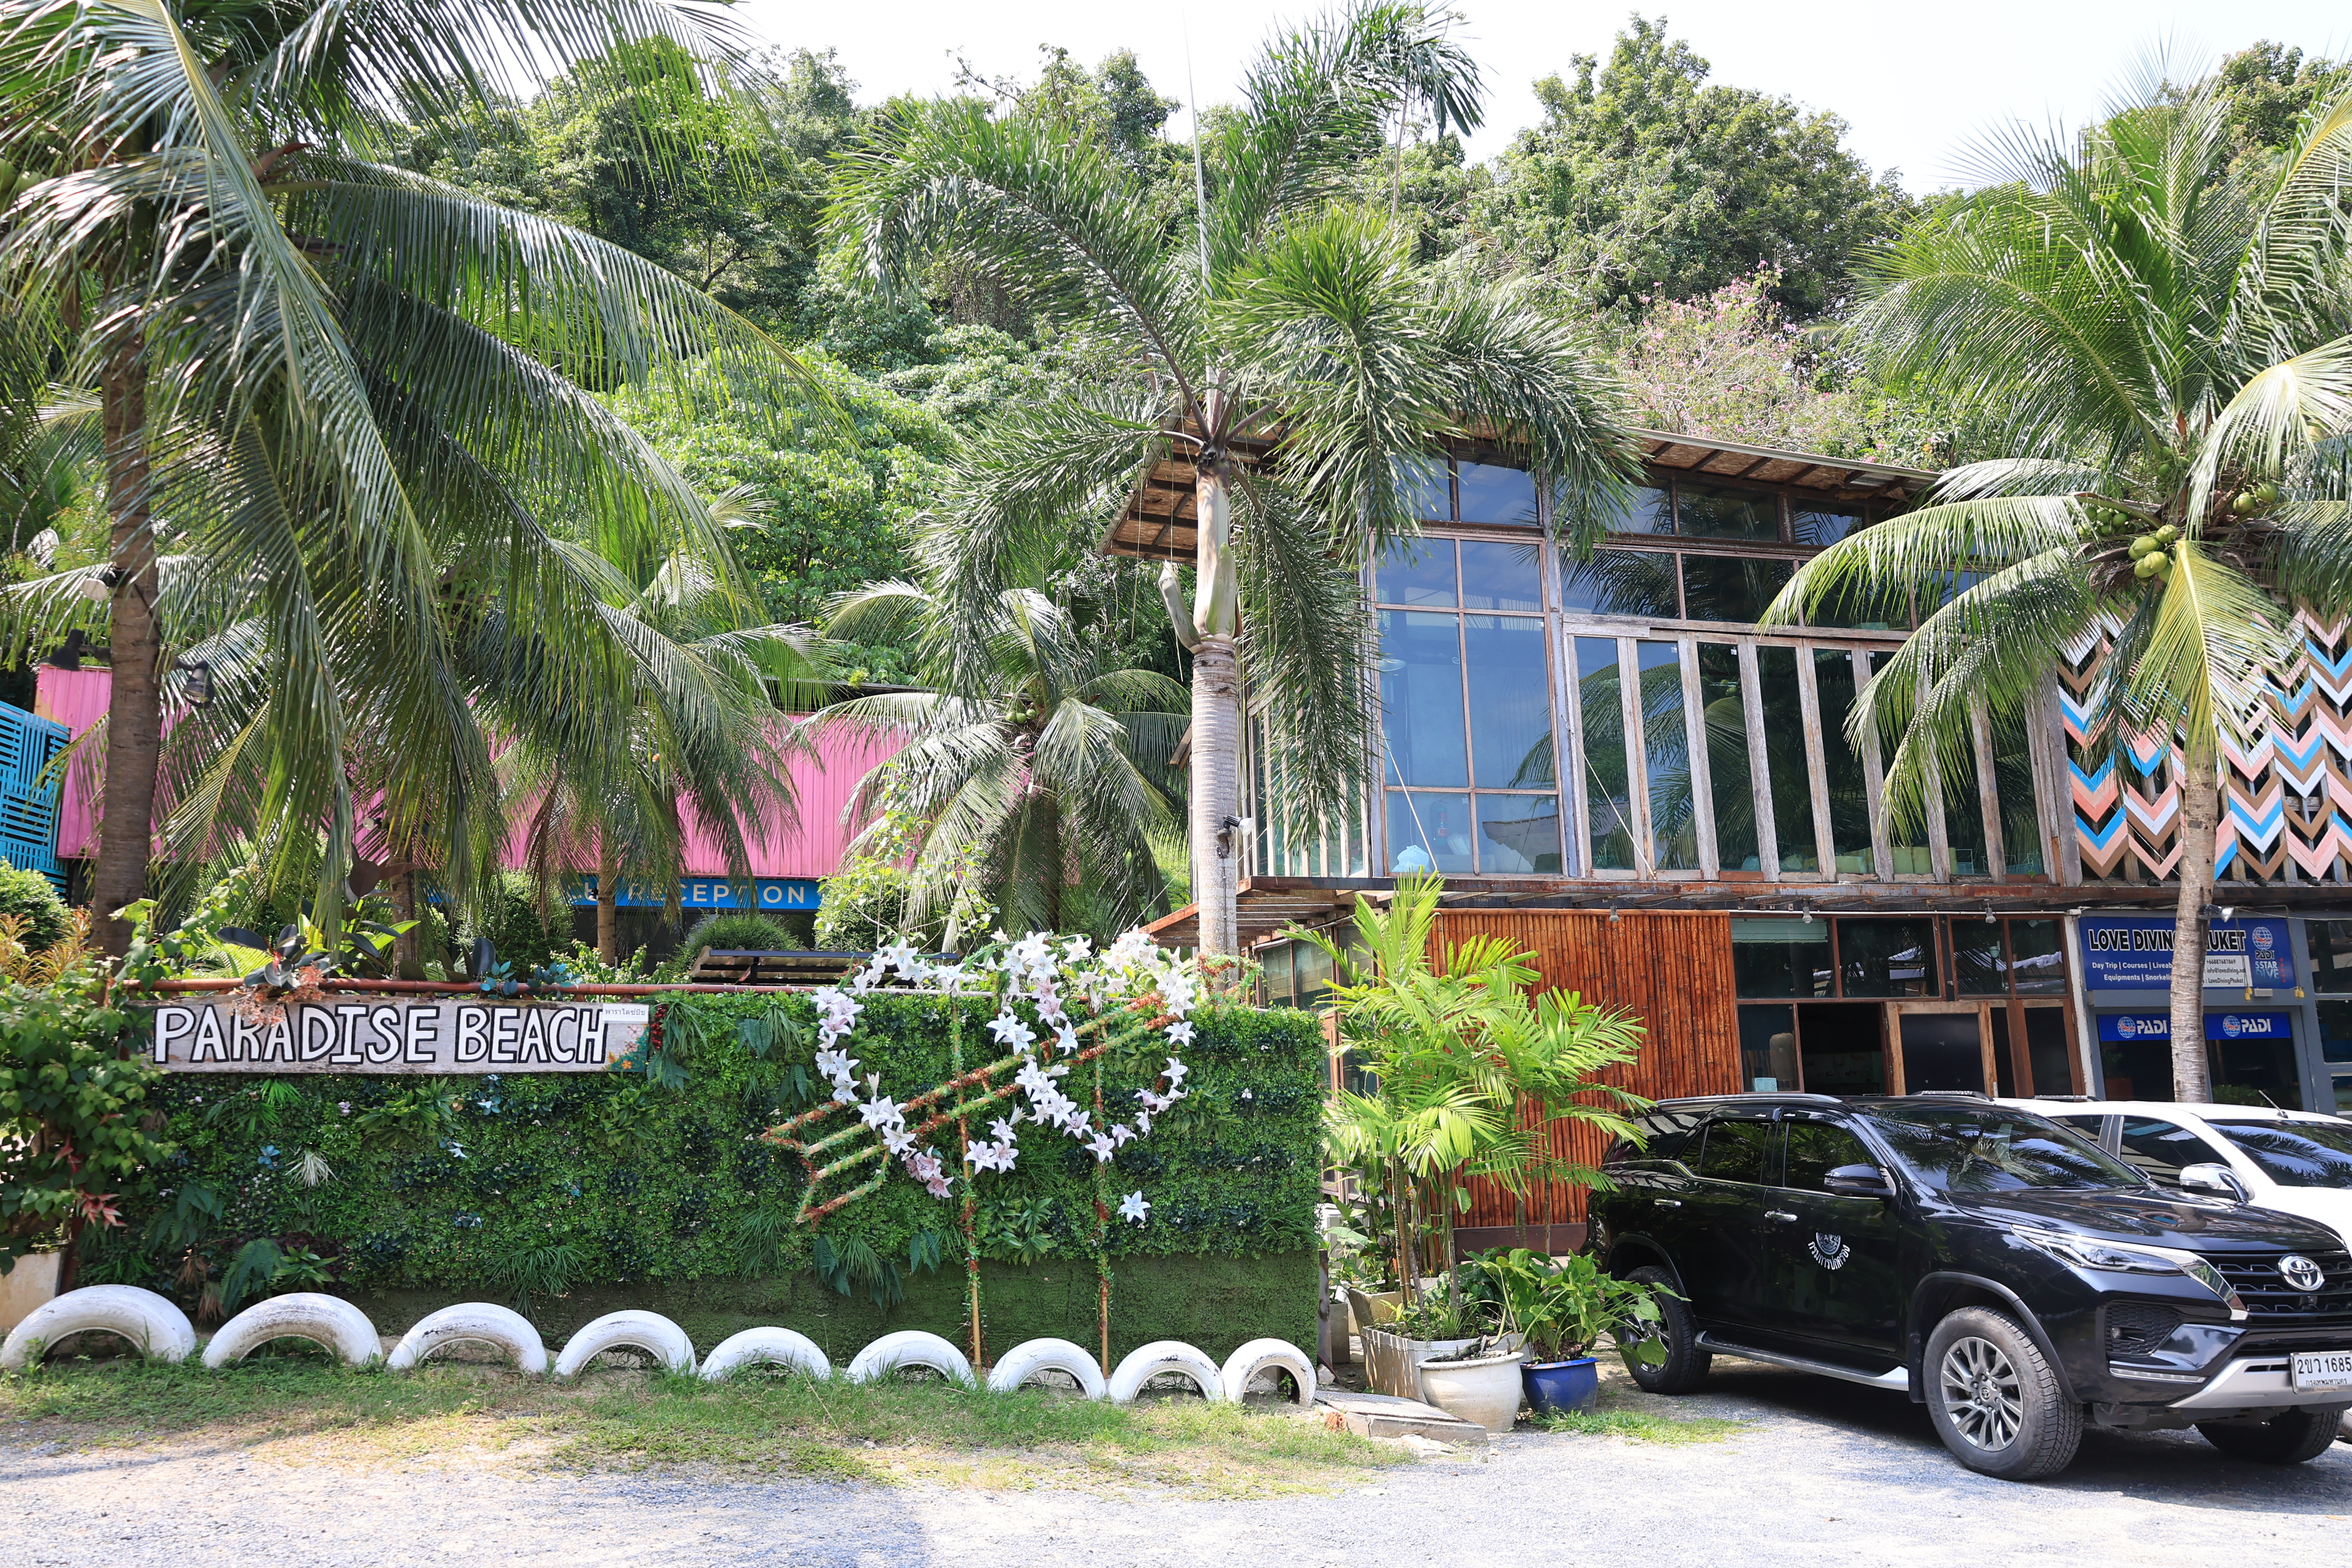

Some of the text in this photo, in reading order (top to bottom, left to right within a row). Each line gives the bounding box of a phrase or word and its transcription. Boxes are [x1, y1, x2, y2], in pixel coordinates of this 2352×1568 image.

[2088, 929, 2246, 951] LOVE DIVIN UKET
[2255, 950, 2275, 959] PADI
[2255, 969, 2279, 979] DIVE
[2137, 1020, 2168, 1034] PADI
[2241, 1018, 2272, 1032] PADI
[153, 1004, 608, 1064] PARADISE BEACH
[1808, 1241, 1850, 1270] กรมการปกครอง
[2324, 1357, 2352, 1373] 1685
